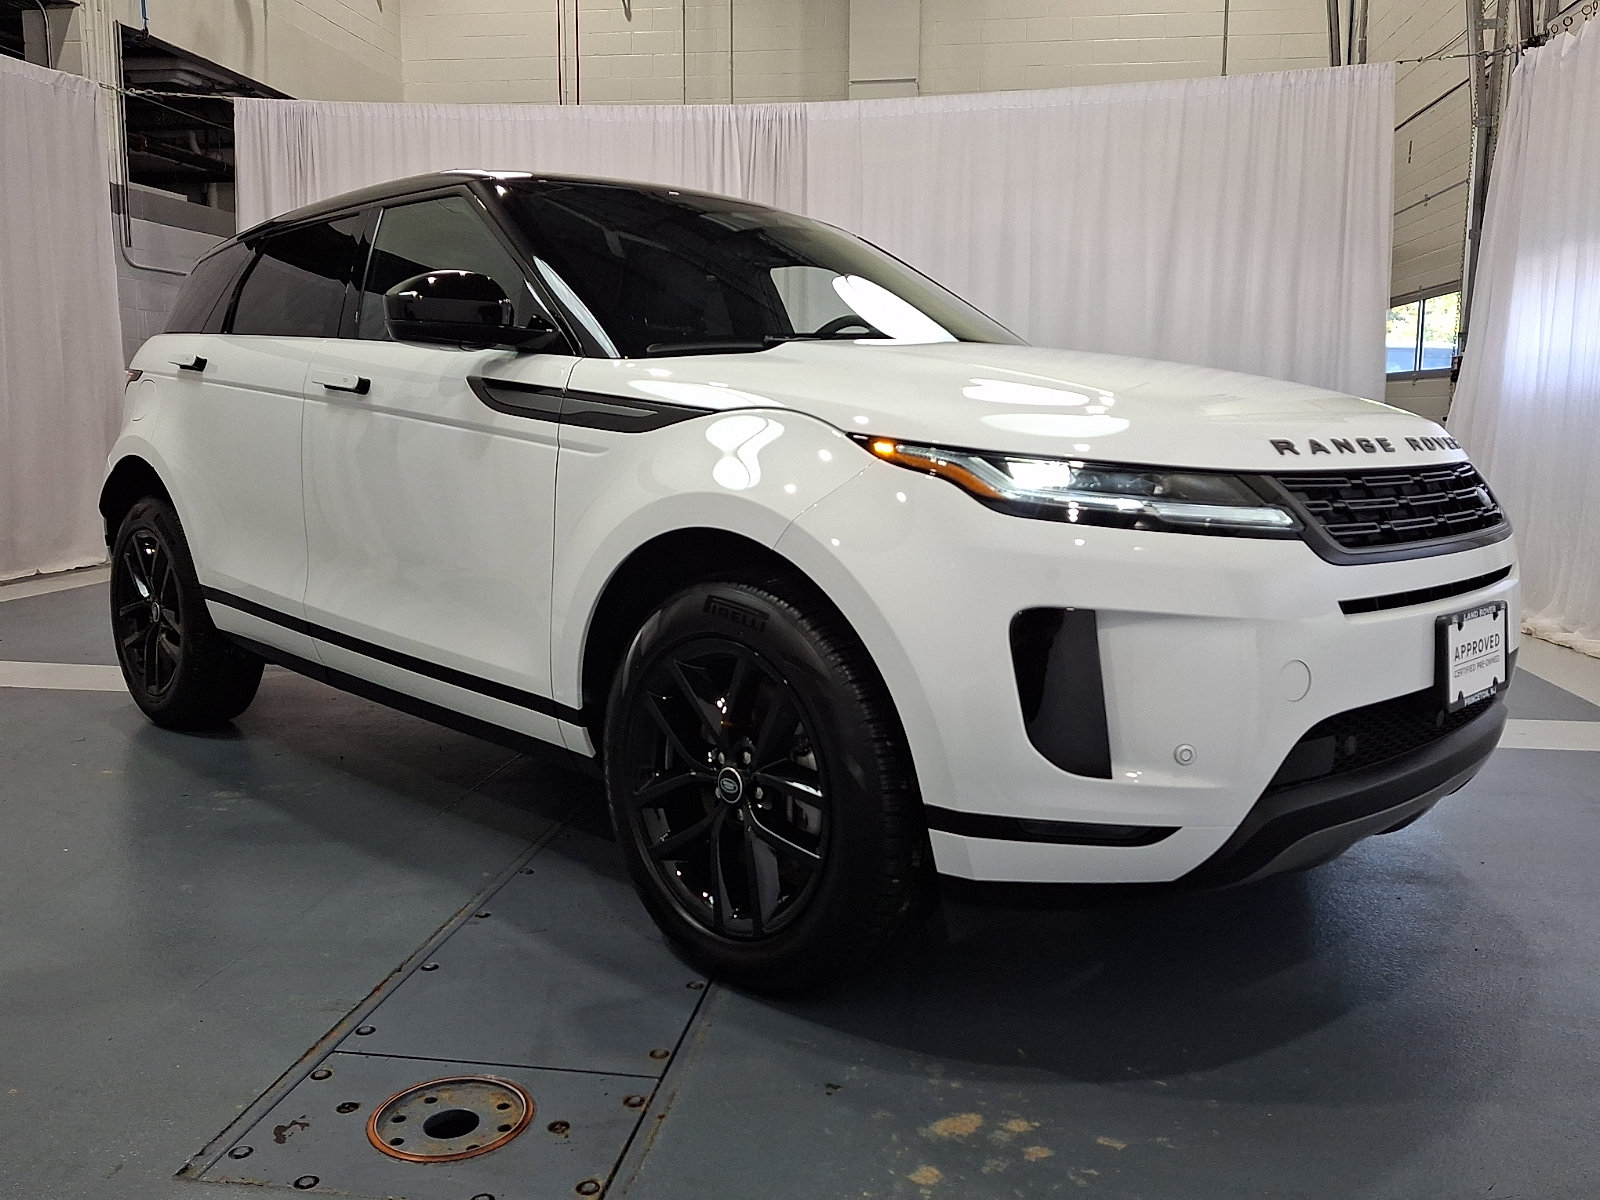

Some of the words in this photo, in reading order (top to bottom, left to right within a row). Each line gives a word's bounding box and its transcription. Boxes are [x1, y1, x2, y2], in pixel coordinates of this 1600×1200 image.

[1269, 437, 1396, 456] RANGE
[703, 594, 770, 632] PIRELLI
[1463, 611, 1479, 621] LAND
[1479, 605, 1497, 617] ROVER
[1454, 633, 1500, 662] APPROVED
[1454, 664, 1477, 678] CERTIFIED
[1477, 655, 1501, 670] PRE-OWNED
